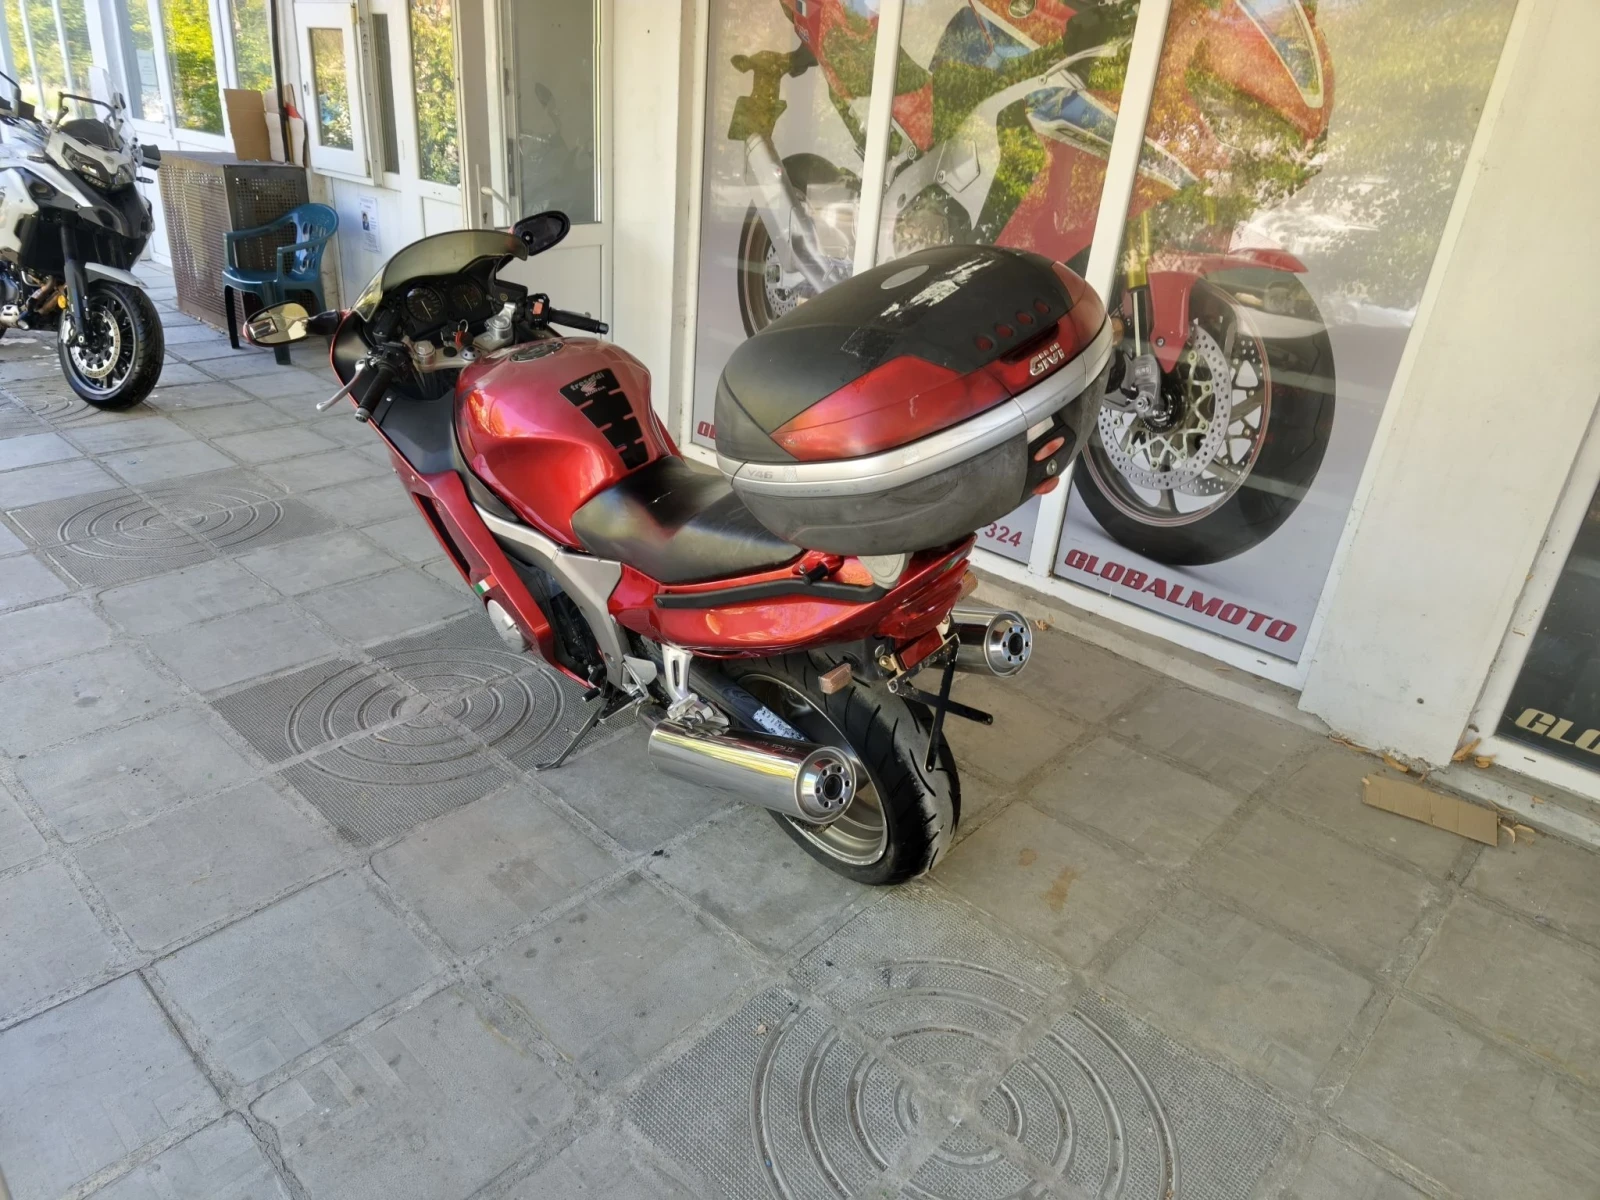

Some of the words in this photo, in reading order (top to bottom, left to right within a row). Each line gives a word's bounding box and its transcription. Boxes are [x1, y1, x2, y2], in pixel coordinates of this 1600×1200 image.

[1030, 342, 1065, 376] GIVI
[984, 522, 1022, 547] 324
[1064, 548, 1298, 643] GLOBALMOTO
